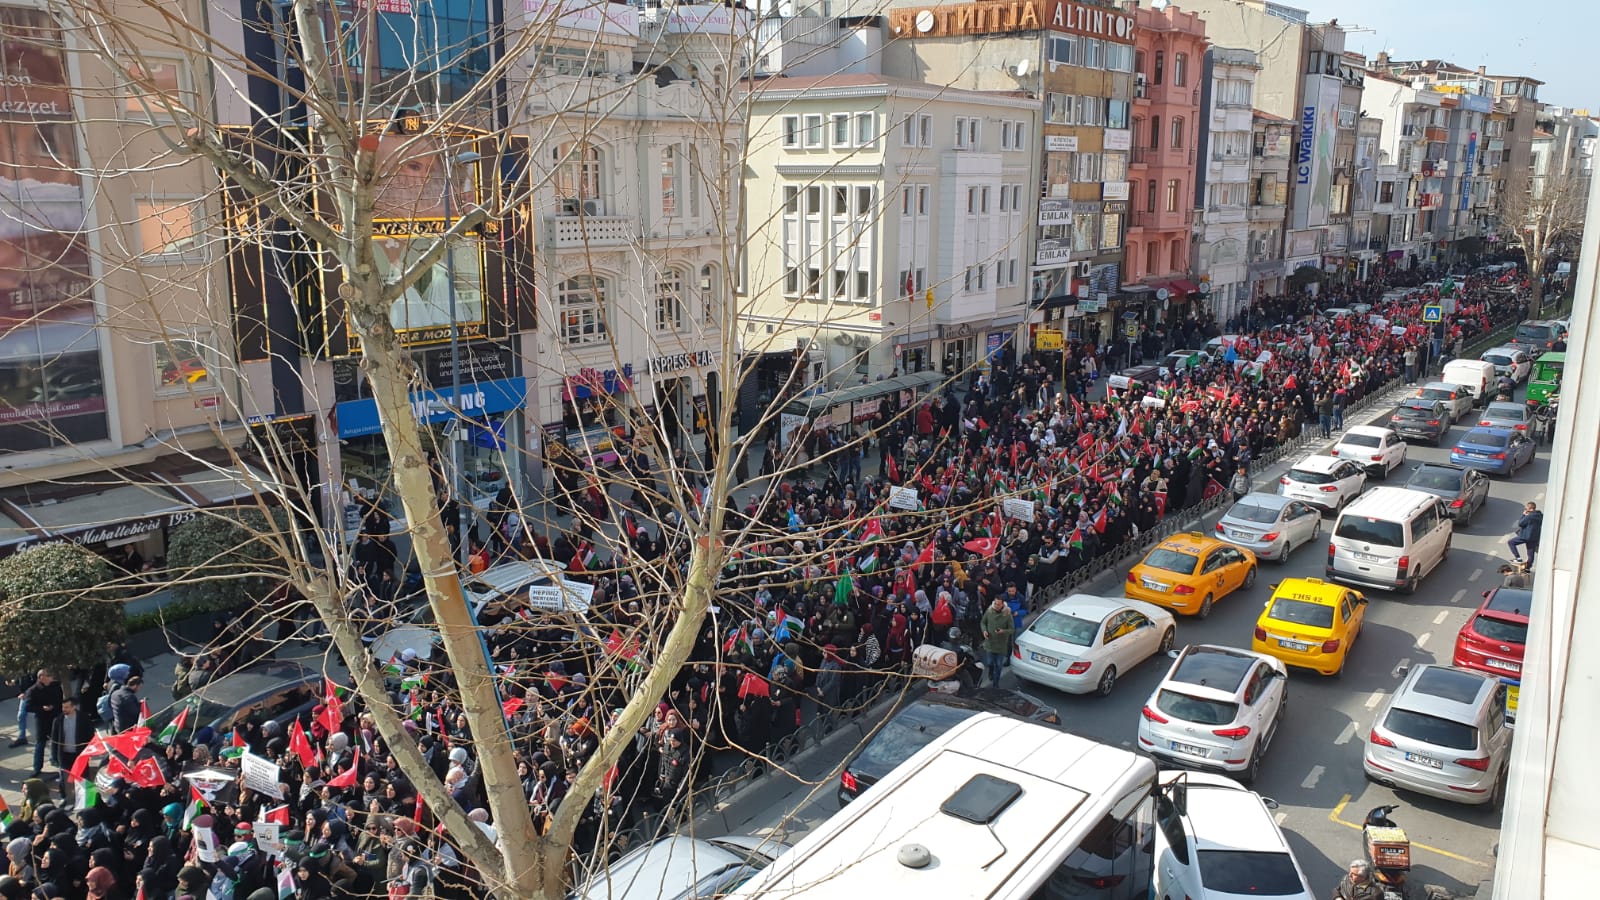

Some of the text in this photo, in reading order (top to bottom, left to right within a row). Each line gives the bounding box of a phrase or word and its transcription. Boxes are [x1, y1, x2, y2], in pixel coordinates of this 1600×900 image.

[1297, 166, 1309, 184] LC
[1041, 210, 1069, 221] EMLAK
[1040, 249, 1067, 260] EMLAK
[423, 328, 460, 340] MOD
[1292, 593, 1311, 601] THS
